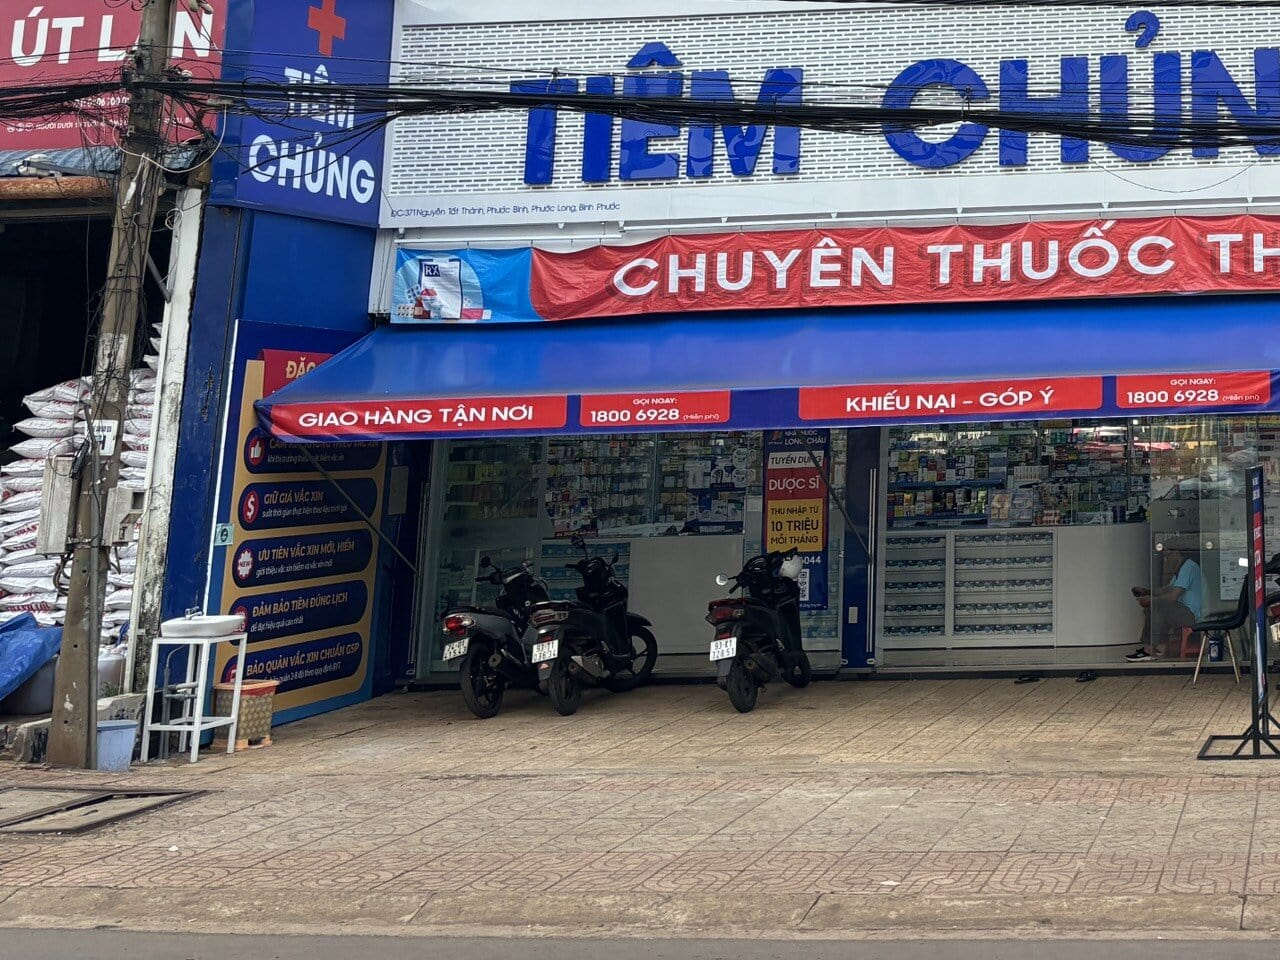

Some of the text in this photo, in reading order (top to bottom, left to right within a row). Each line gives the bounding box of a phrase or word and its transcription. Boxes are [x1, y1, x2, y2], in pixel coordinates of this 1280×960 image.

[10, 6, 215, 67] ÚT LN
[510, 41, 803, 186] TIÊM
[248, 132, 376, 204] CHỦNG
[425, 264, 440, 277] RX
[613, 237, 895, 297] CHUYÊN
[926, 220, 1176, 284] THUỐC
[632, 398, 651, 407] GỌI
[846, 389, 913, 413] KHIẾU
[916, 394, 956, 415] NẠI
[978, 386, 1032, 407] GÓP
[1037, 385, 1056, 406] Ý
[1126, 390, 1169, 404] 1800
[1173, 388, 1220, 403] 6928
[298, 410, 359, 428] GIAO
[364, 403, 433, 425] HÀNG
[439, 403, 488, 428] TẬN
[492, 403, 533, 422] NƠI
[590, 408, 631, 423] 1800
[636, 407, 680, 422] 6928
[769, 477, 806, 493] DƯỢC
[771, 517, 820, 534] 10 TRIỆU
